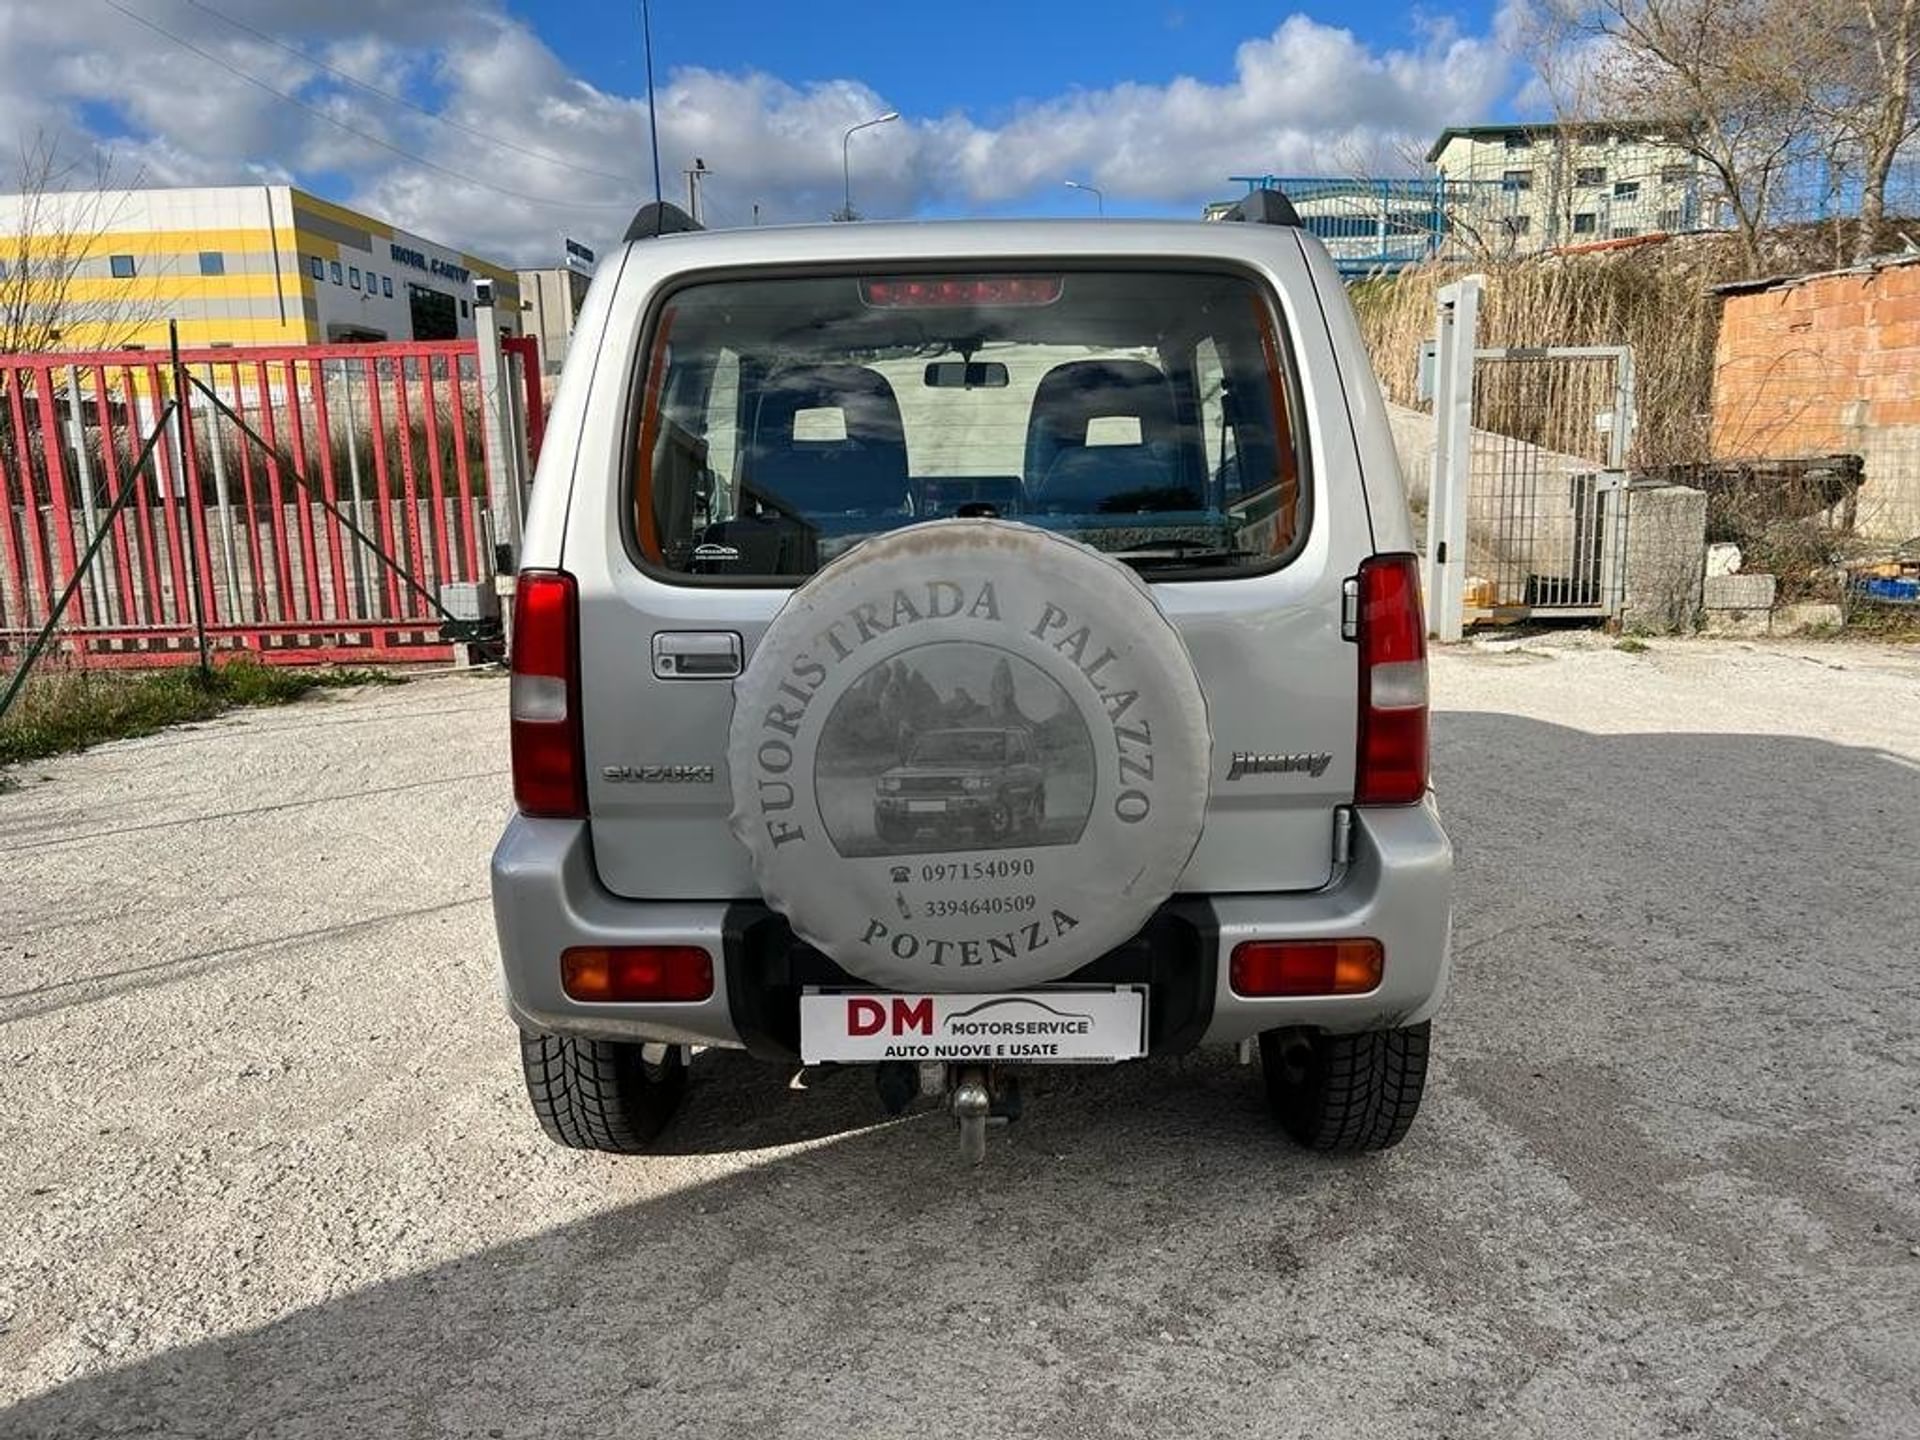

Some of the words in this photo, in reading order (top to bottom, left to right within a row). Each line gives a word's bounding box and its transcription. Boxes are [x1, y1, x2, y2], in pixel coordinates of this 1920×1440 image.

[757, 579, 1002, 850] FUORISTRADA
[1029, 600, 1155, 825] PALAZZO
[602, 765, 714, 783] SUZUKI
[921, 858, 1035, 883] 097154090
[924, 893, 1037, 918] 3394640509
[859, 907, 1080, 968] POTENZA
[846, 997, 933, 1037] DM
[951, 1021, 1089, 1036] MOTORSERVICE
[884, 1045, 929, 1058] AUTO
[935, 1045, 992, 1057] NUOVE
[996, 1045, 1005, 1056] E
[1010, 1044, 1059, 1056] USATE
